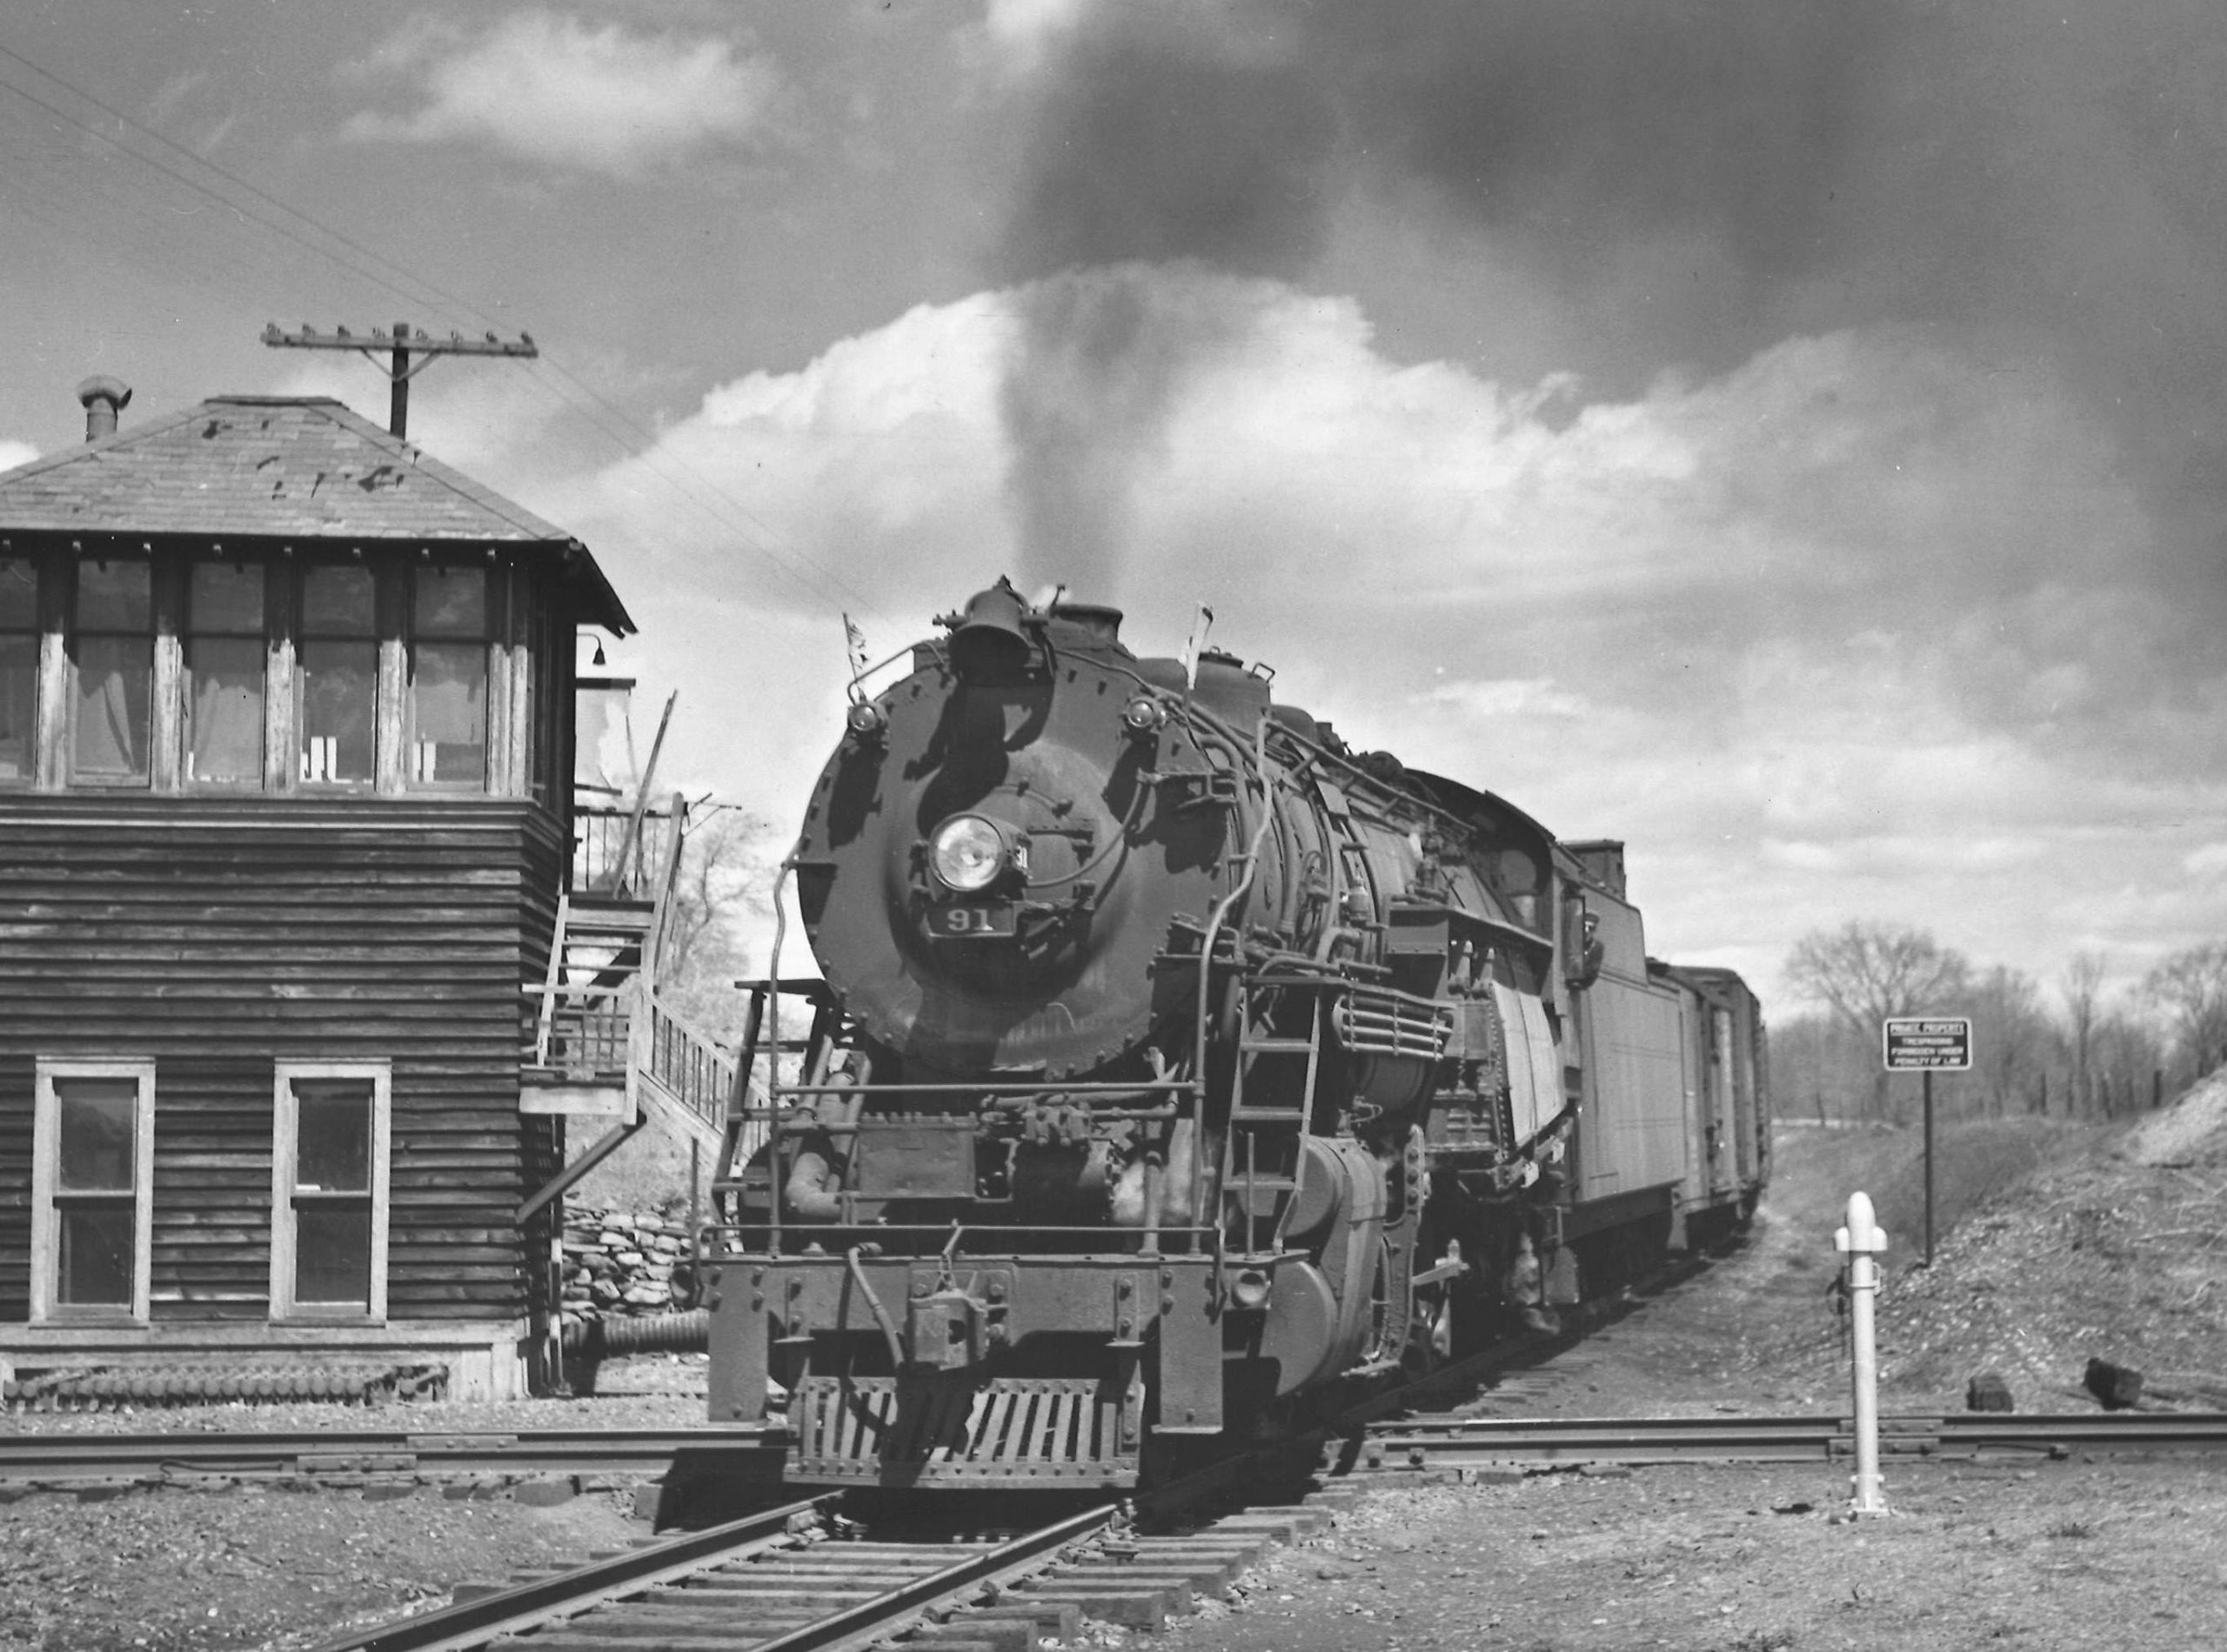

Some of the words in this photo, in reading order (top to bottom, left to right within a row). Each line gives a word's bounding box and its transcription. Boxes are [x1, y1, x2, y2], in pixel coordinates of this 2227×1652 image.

[947, 909, 993, 931] 91
[1930, 1057, 1941, 1066] OF
[1943, 1057, 1962, 1066] LAW
